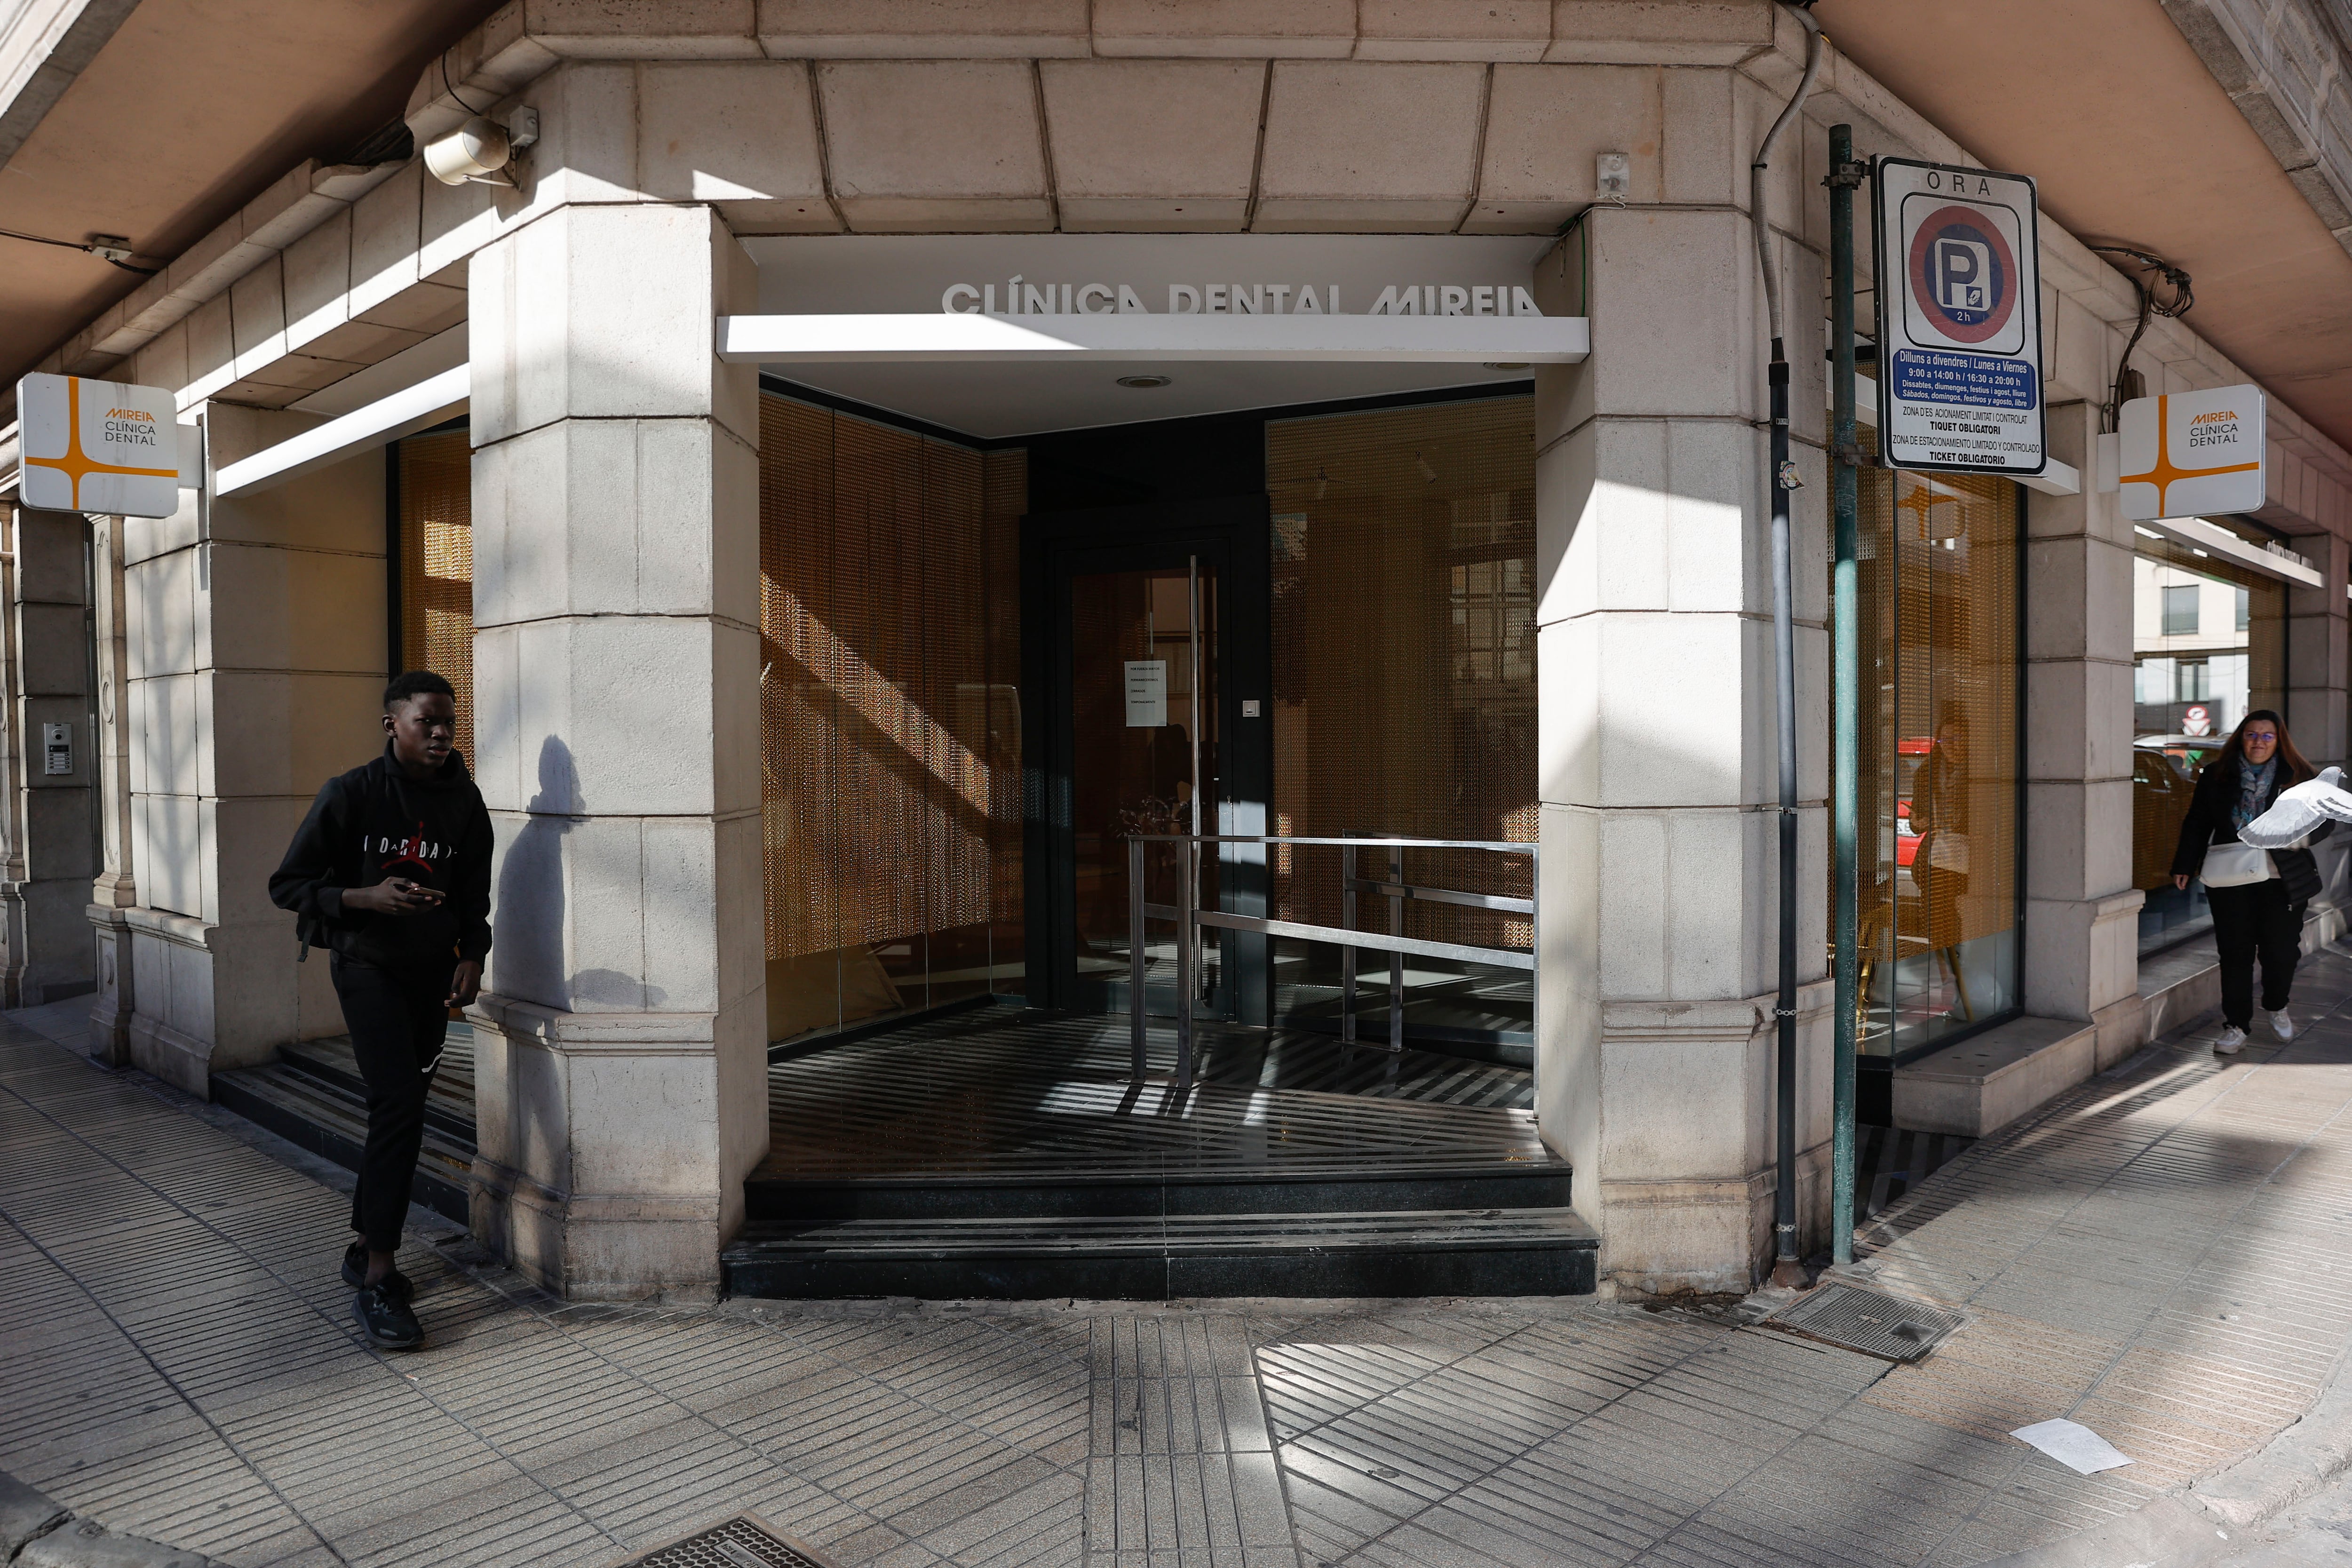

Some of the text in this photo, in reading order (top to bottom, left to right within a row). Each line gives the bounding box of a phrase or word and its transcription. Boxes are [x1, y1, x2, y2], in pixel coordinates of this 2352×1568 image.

[1927, 171, 1990, 196] ORA
[942, 274, 1544, 317] CLÍNICA DENTAL MIREIA
[1900, 350, 1925, 364] Dilluns
[1927, 356, 1931, 364] a
[1933, 354, 1968, 368] divendres
[1969, 357, 1972, 368] /
[1974, 358, 1995, 371] Lunes
[2002, 360, 2027, 374] Viernes
[1908, 368, 1925, 377] 9:00
[1934, 370, 1954, 380] 14:00
[1956, 372, 1961, 381] h
[1962, 373, 1965, 381] /
[1967, 373, 1986, 383] 16:30
[1995, 376, 2014, 386] 20:00
[2016, 378, 2020, 386] h
[1902, 379, 1933, 390] Dissabtes,
[1934, 382, 1969, 393] diumenges,
[1970, 385, 1989, 394] festius
[1902, 389, 1930, 399] Sábados,
[1931, 391, 1963, 402] domingos,
[1963, 394, 1986, 403] festivos
[105, 408, 155, 422] MIREIA
[1903, 406, 1919, 416] ZONA
[1972, 412, 1992, 422] LIMITAT
[1995, 413, 2027, 424] CONTROLAT
[2190, 411, 2238, 425] MIREIA
[105, 421, 156, 435] CLÍNICA
[1930, 421, 2000, 434] TIQUET OBLIGATORI
[2190, 423, 2238, 437] CLÍNICA
[105, 432, 156, 446] DENTAL
[1893, 435, 2040, 453] ZONA DE ESTACIONAMIENTO LIMITADO Y CONTROLADO
[2190, 434, 2238, 447] DENTAL
[1930, 452, 2005, 465] TICKET OBLIGATORIO
